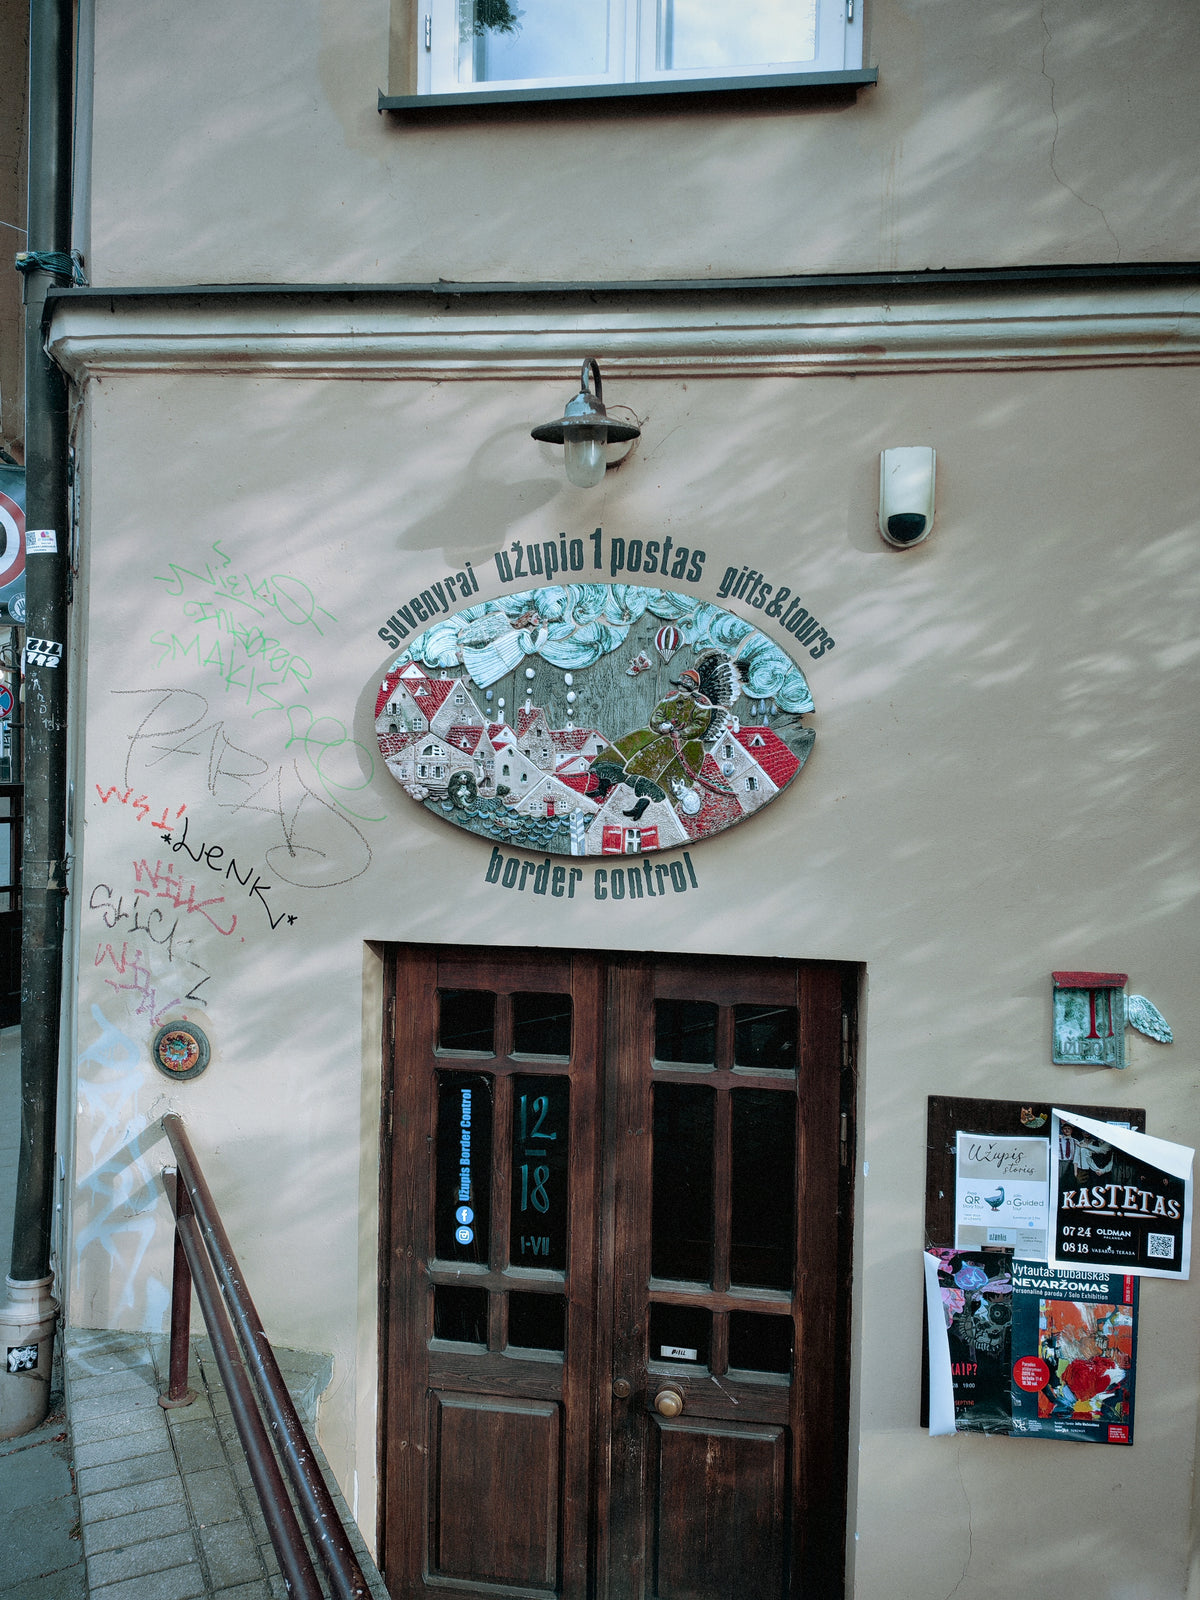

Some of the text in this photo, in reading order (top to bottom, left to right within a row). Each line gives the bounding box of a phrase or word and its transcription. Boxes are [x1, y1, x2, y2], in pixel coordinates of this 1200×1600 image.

[378, 562, 480, 650] suvenyrai
[495, 532, 585, 583] užupio
[590, 528, 603, 571] 1
[610, 536, 706, 583] postas
[484, 846, 699, 900] border control
[520, 1095, 557, 1140] 12
[458, 1088, 472, 1202] Užupis Border Control
[968, 1143, 1026, 1169] Užupis
[520, 1164, 549, 1214] 18
[965, 1196, 980, 1205] QR
[1013, 1198, 1044, 1208] Guided
[1061, 1184, 1181, 1219] KASTETAS
[1062, 1225, 1092, 1237] 07 24
[1096, 1228, 1132, 1238] OLDMAN
[1062, 1241, 1089, 1254] 08 18
[1012, 1262, 1056, 1277] Vytautas
[1012, 1276, 1109, 1293] NEVARŽOMAS
[1069, 1291, 1080, 1299] Solo
[1081, 1291, 1109, 1300] Exhibition
